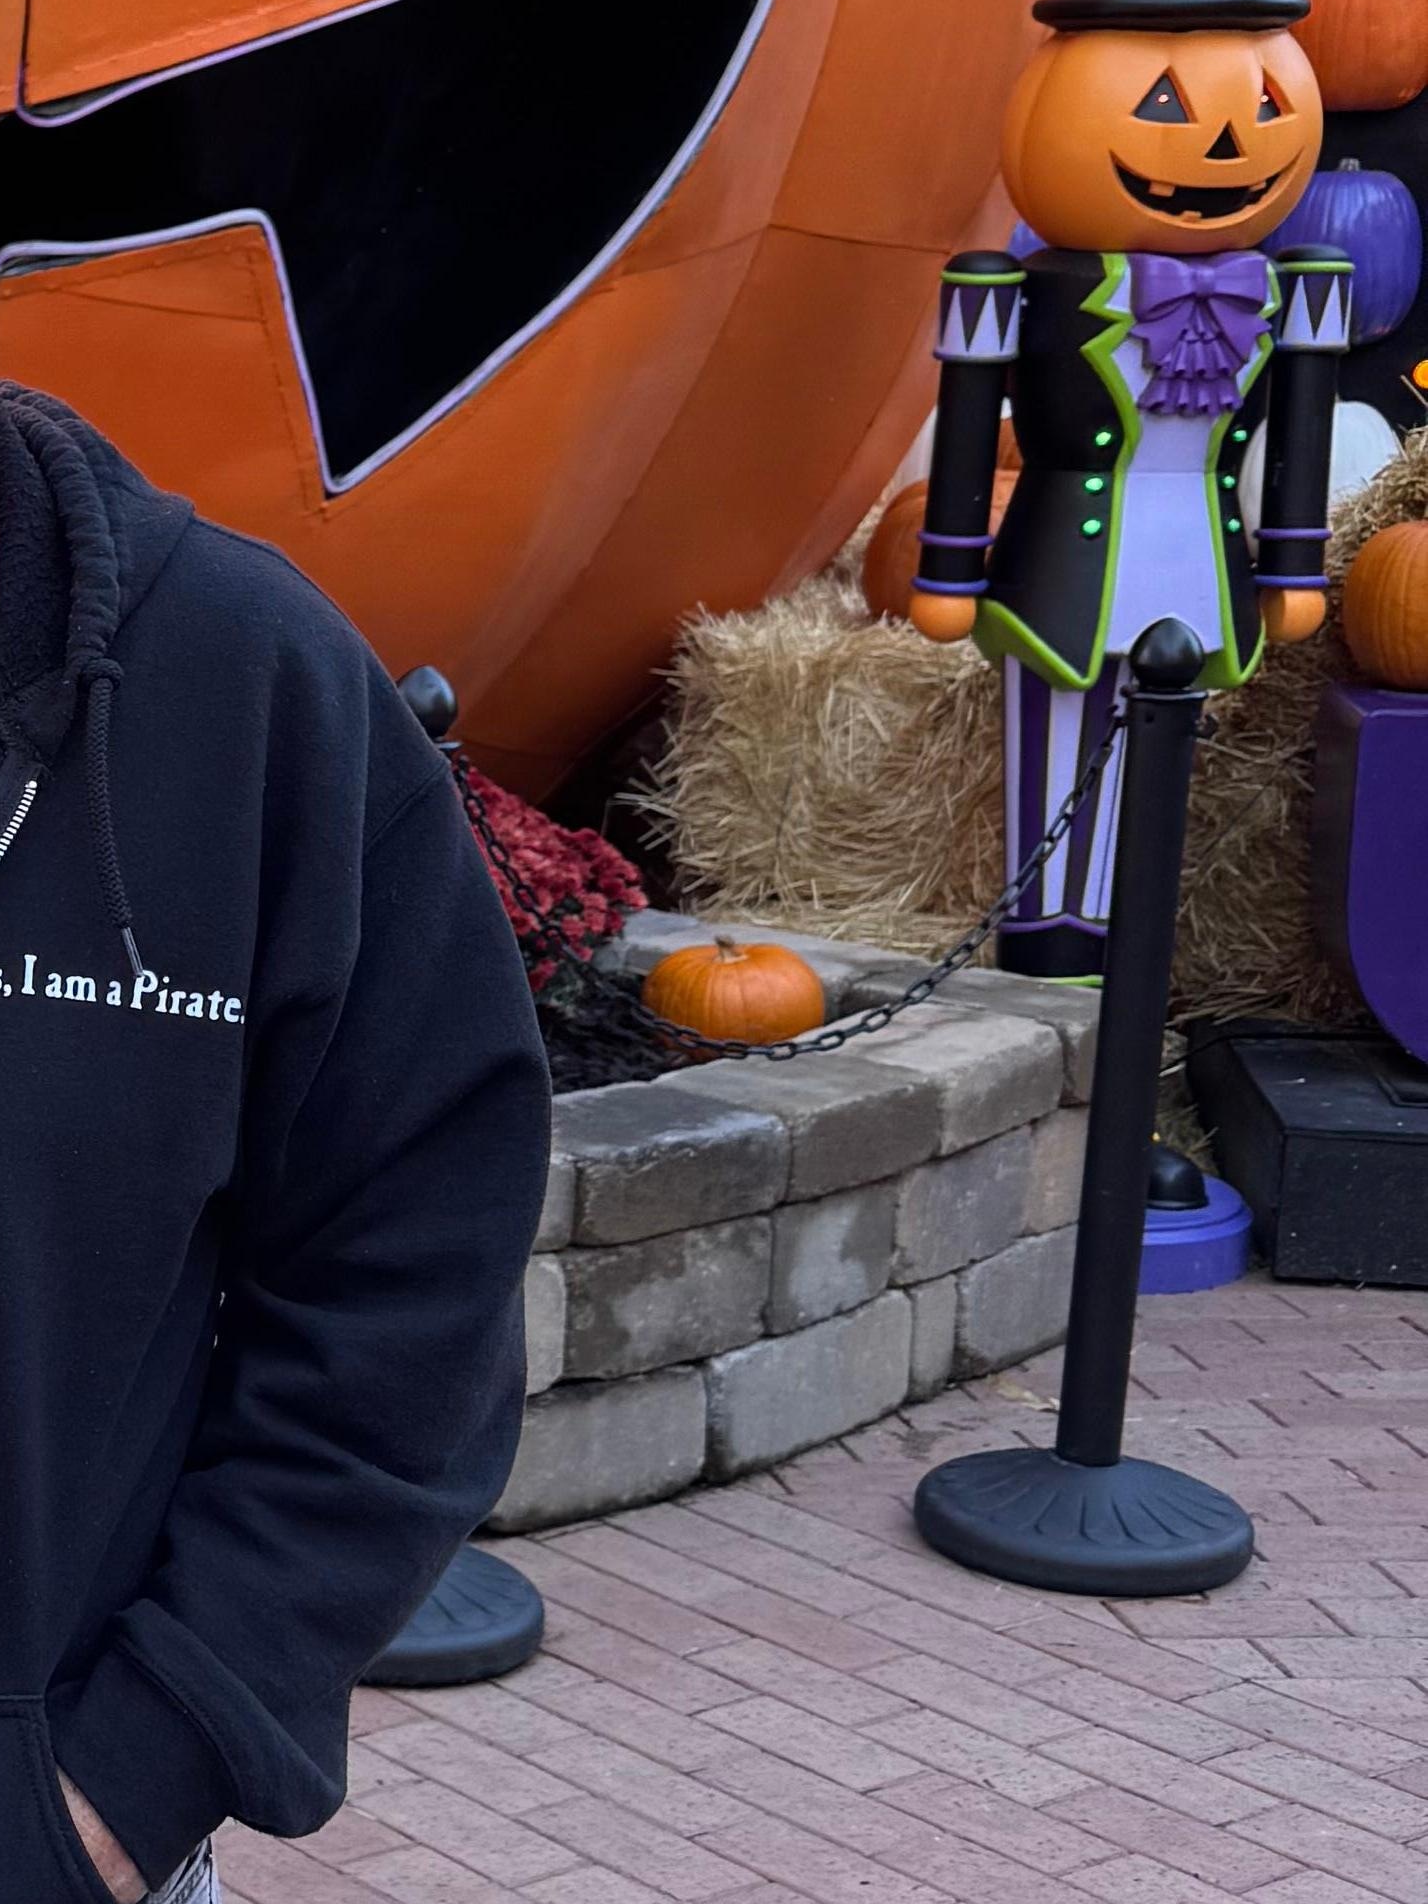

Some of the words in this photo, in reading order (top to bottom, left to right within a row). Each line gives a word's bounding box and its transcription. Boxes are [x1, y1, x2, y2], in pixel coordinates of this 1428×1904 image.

[20, 953, 38, 996] I
[45, 972, 97, 1003] am
[106, 980, 123, 1007] a
